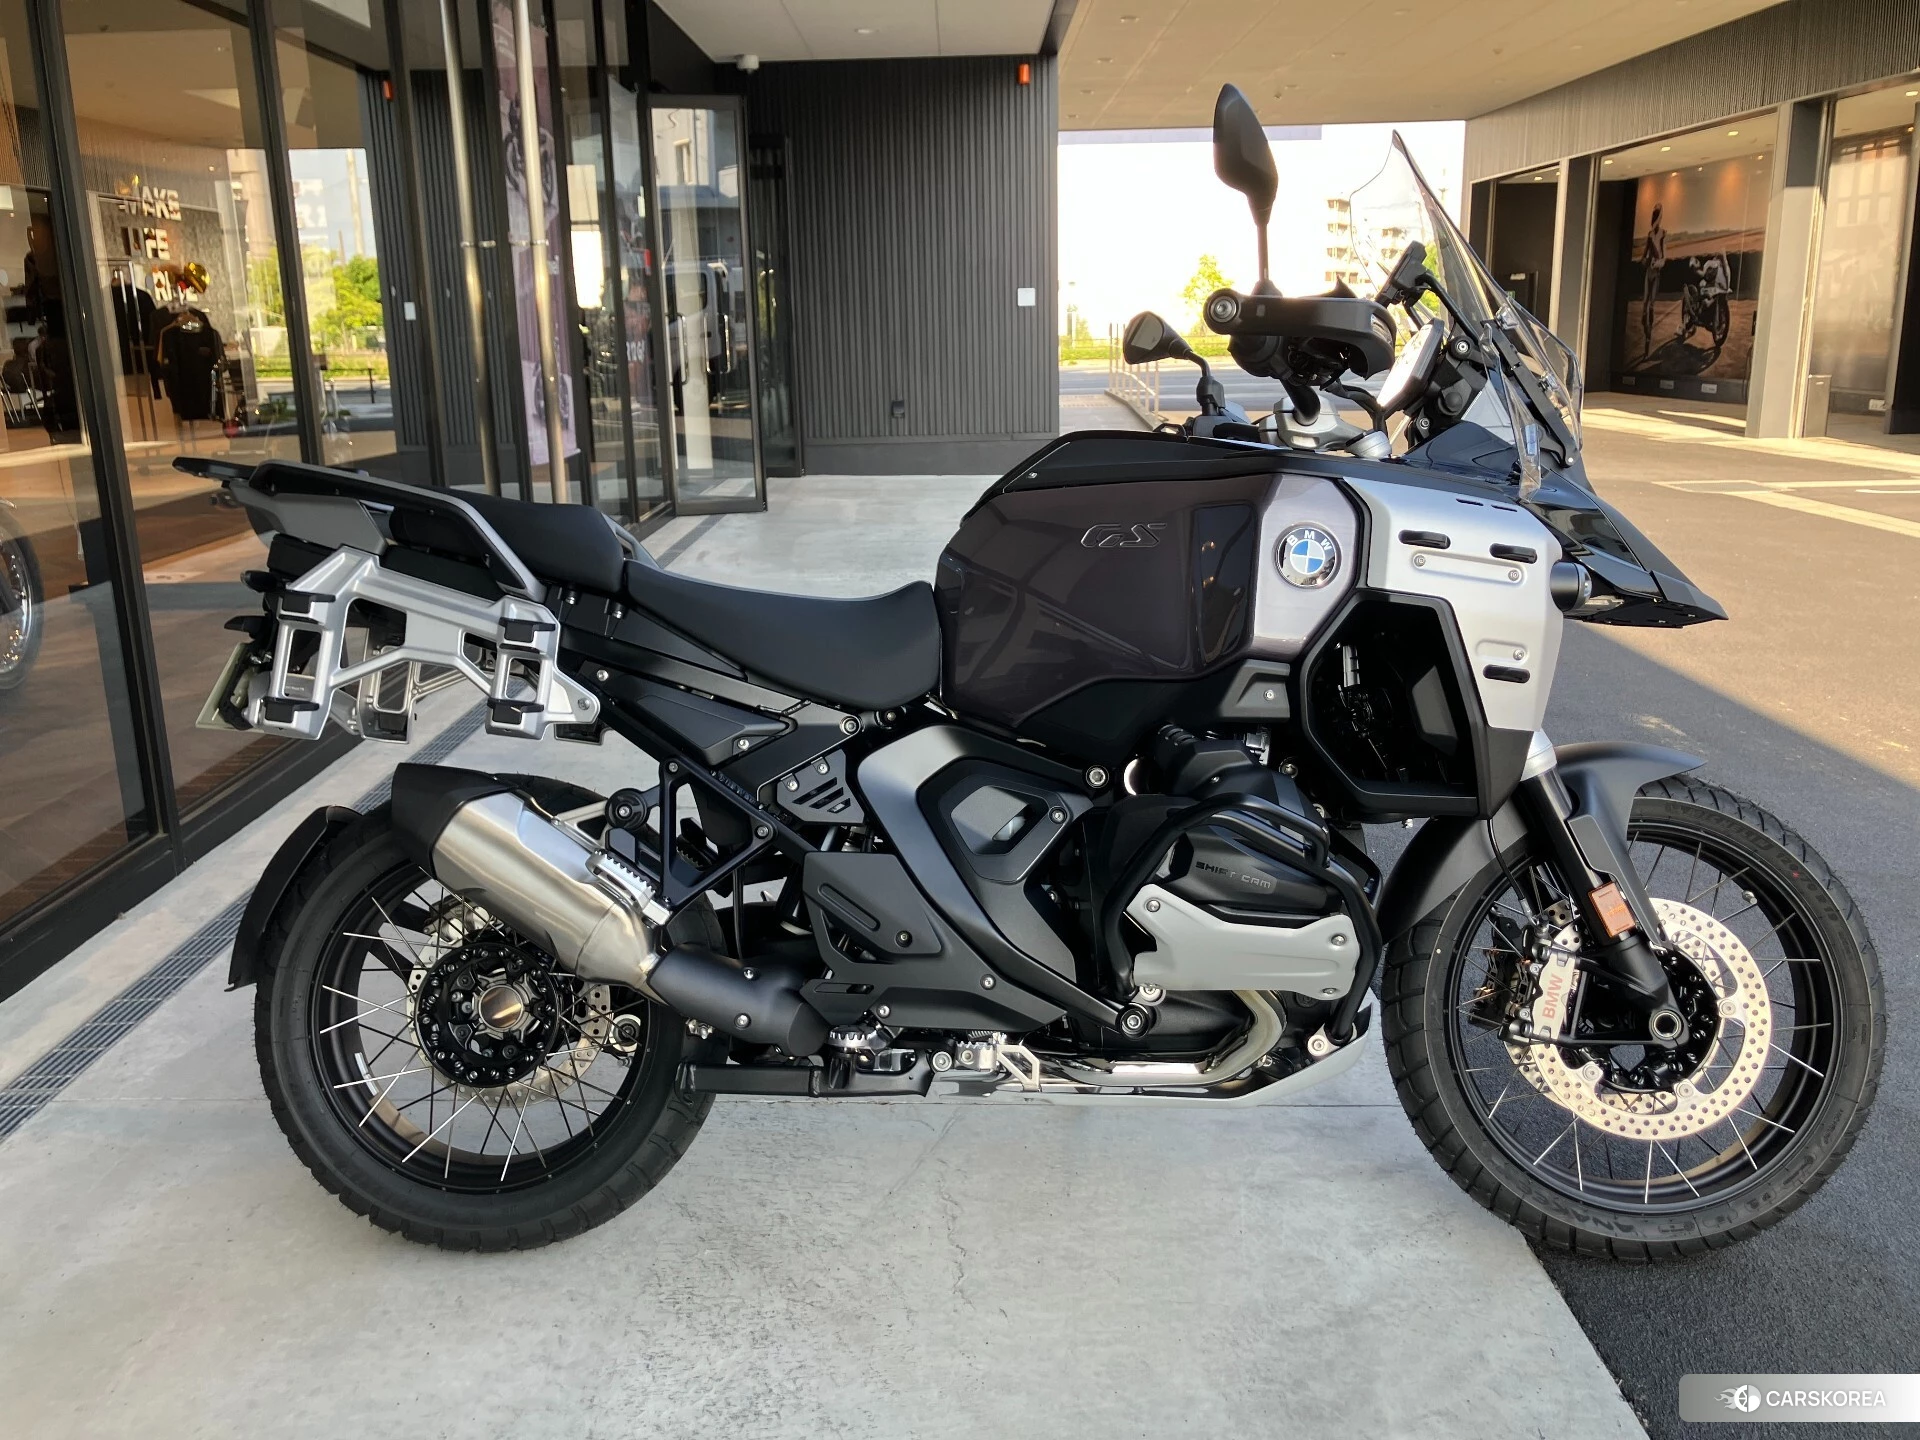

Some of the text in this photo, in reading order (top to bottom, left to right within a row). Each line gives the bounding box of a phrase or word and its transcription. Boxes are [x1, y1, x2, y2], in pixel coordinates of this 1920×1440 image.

[121, 185, 182, 221] MAKE
[1080, 523, 1167, 548] GS
[1287, 529, 1332, 551] BMW
[1195, 861, 1272, 889] SHIFT CAM
[1542, 973, 1564, 1020] BMW
[1515, 1179, 1636, 1234] ANAKEE
